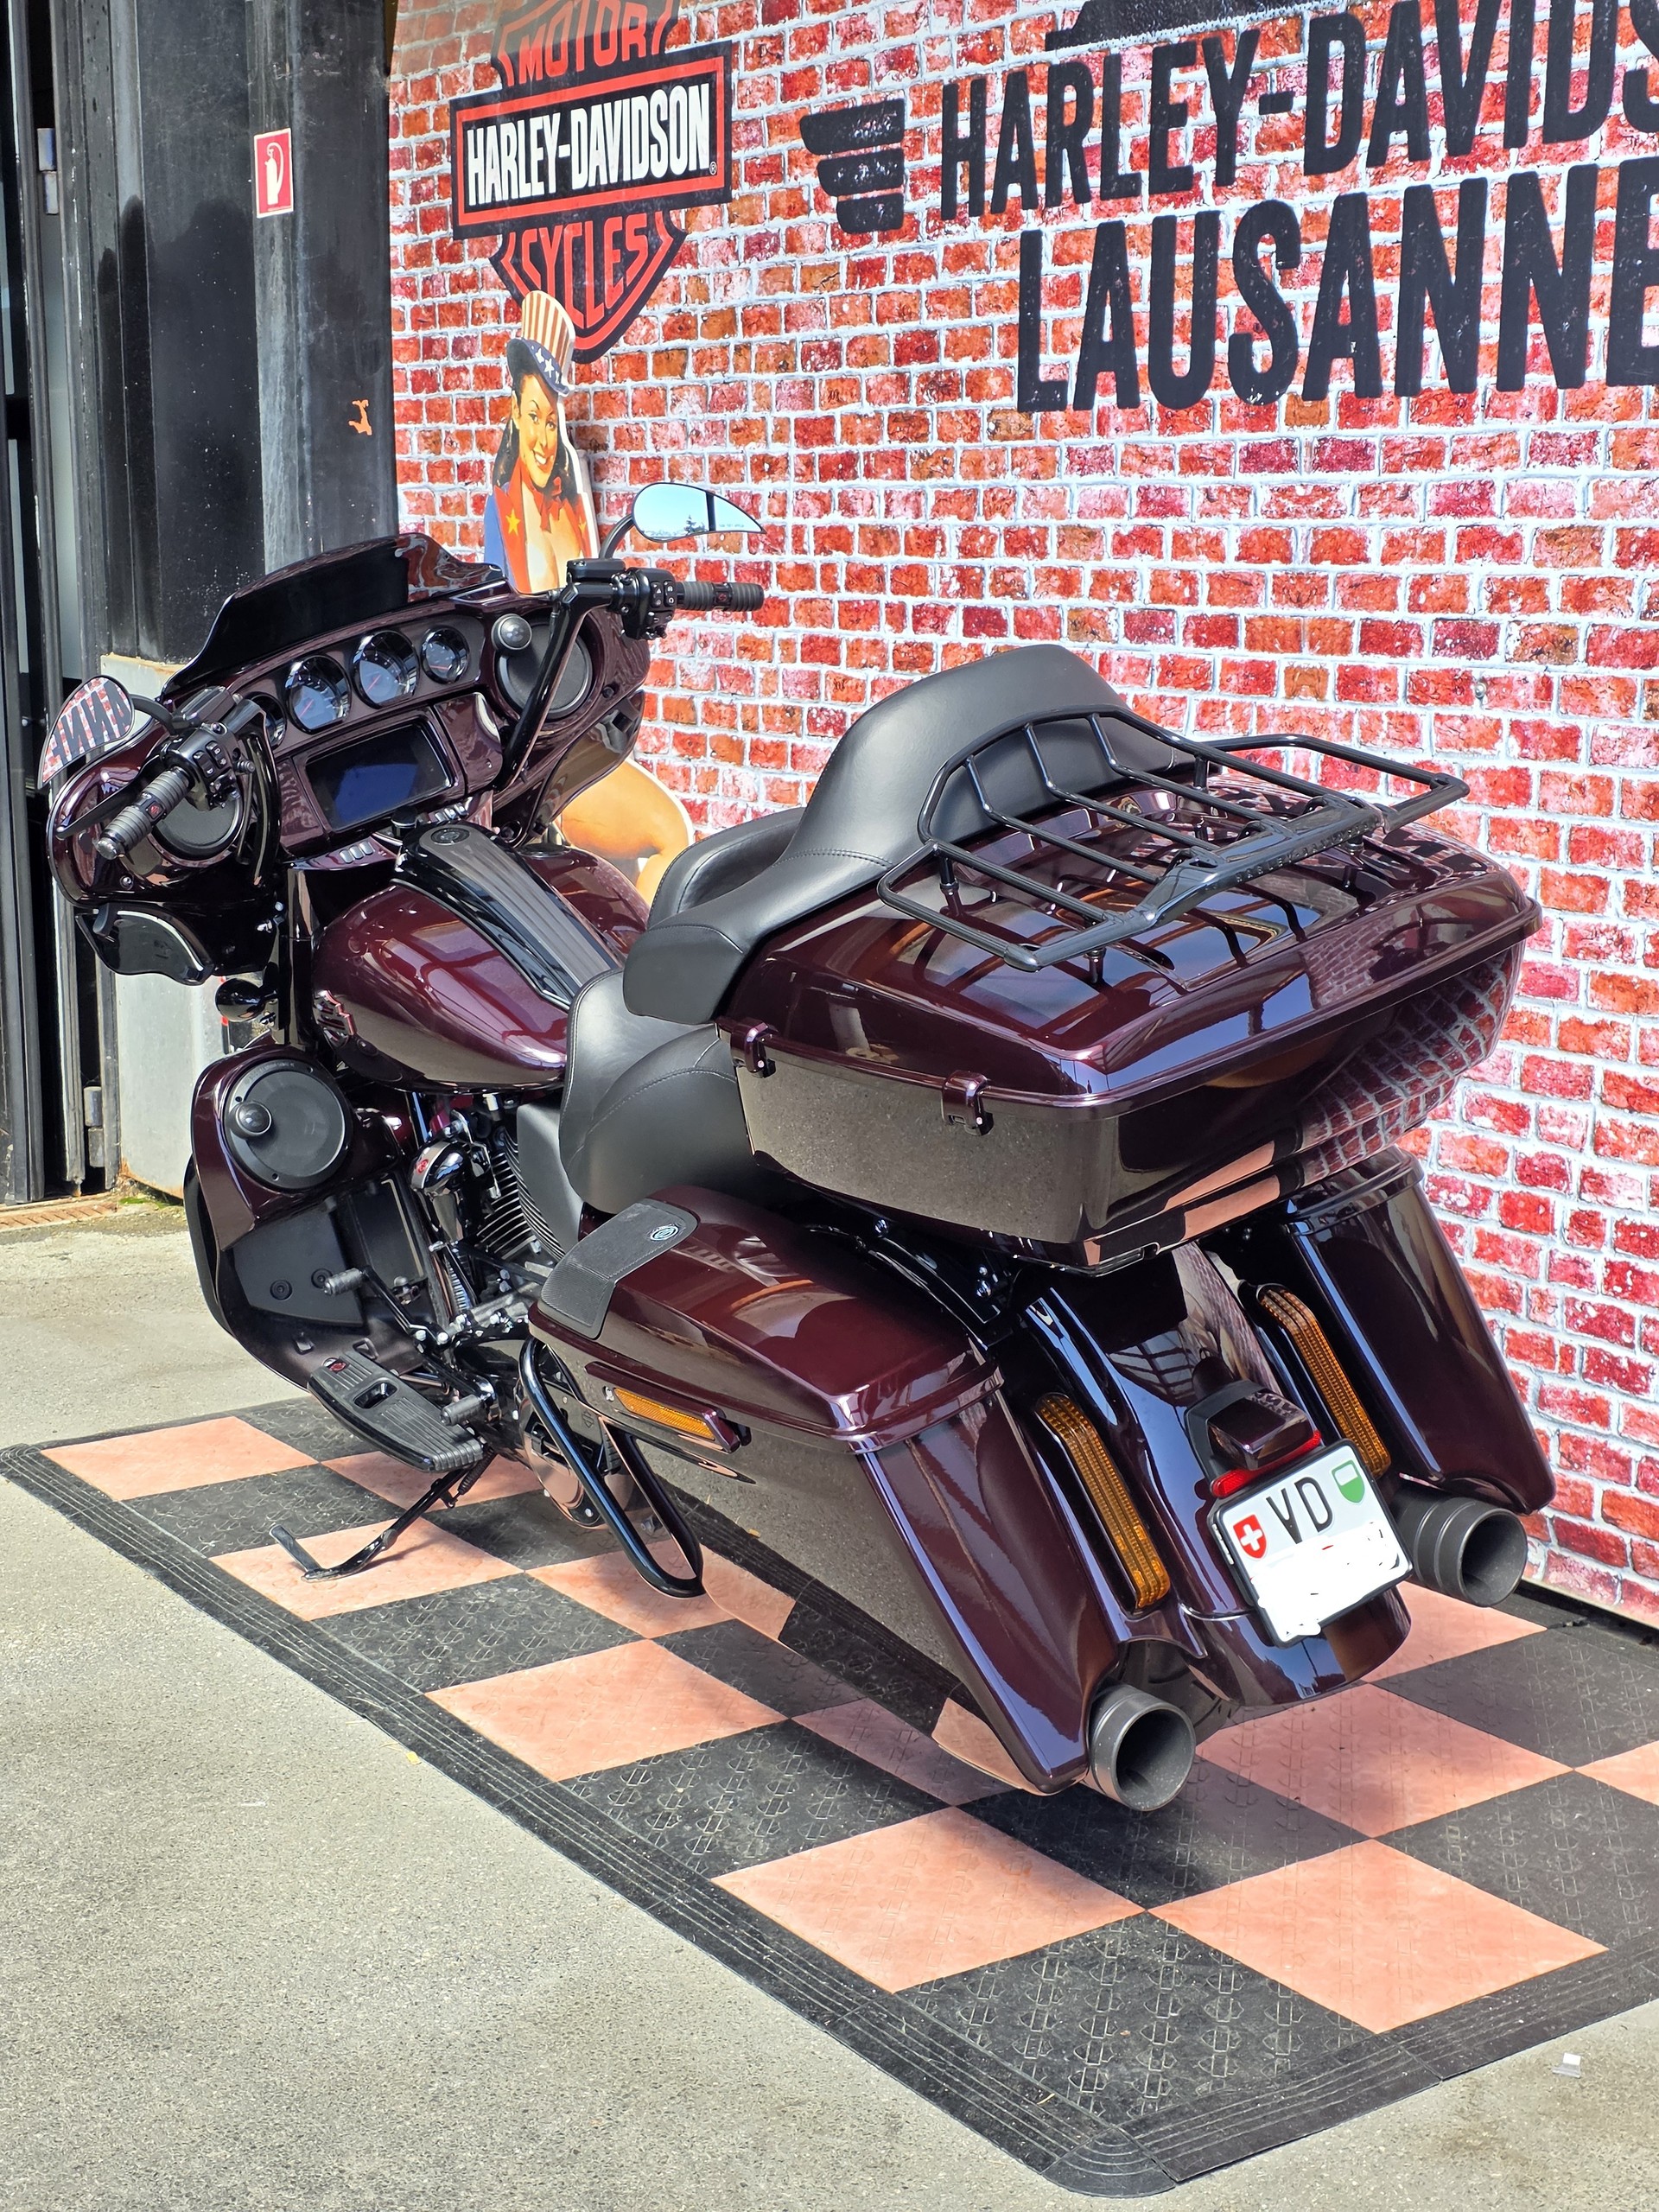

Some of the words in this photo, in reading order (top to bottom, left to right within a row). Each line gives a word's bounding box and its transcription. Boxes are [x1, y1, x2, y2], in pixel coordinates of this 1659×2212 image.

[518, 0, 648, 85] MOTOR
[522, 213, 648, 329] CYCLES
[1017, 156, 1659, 413] LAUSANNE
[1266, 1477, 1332, 1544] VD
